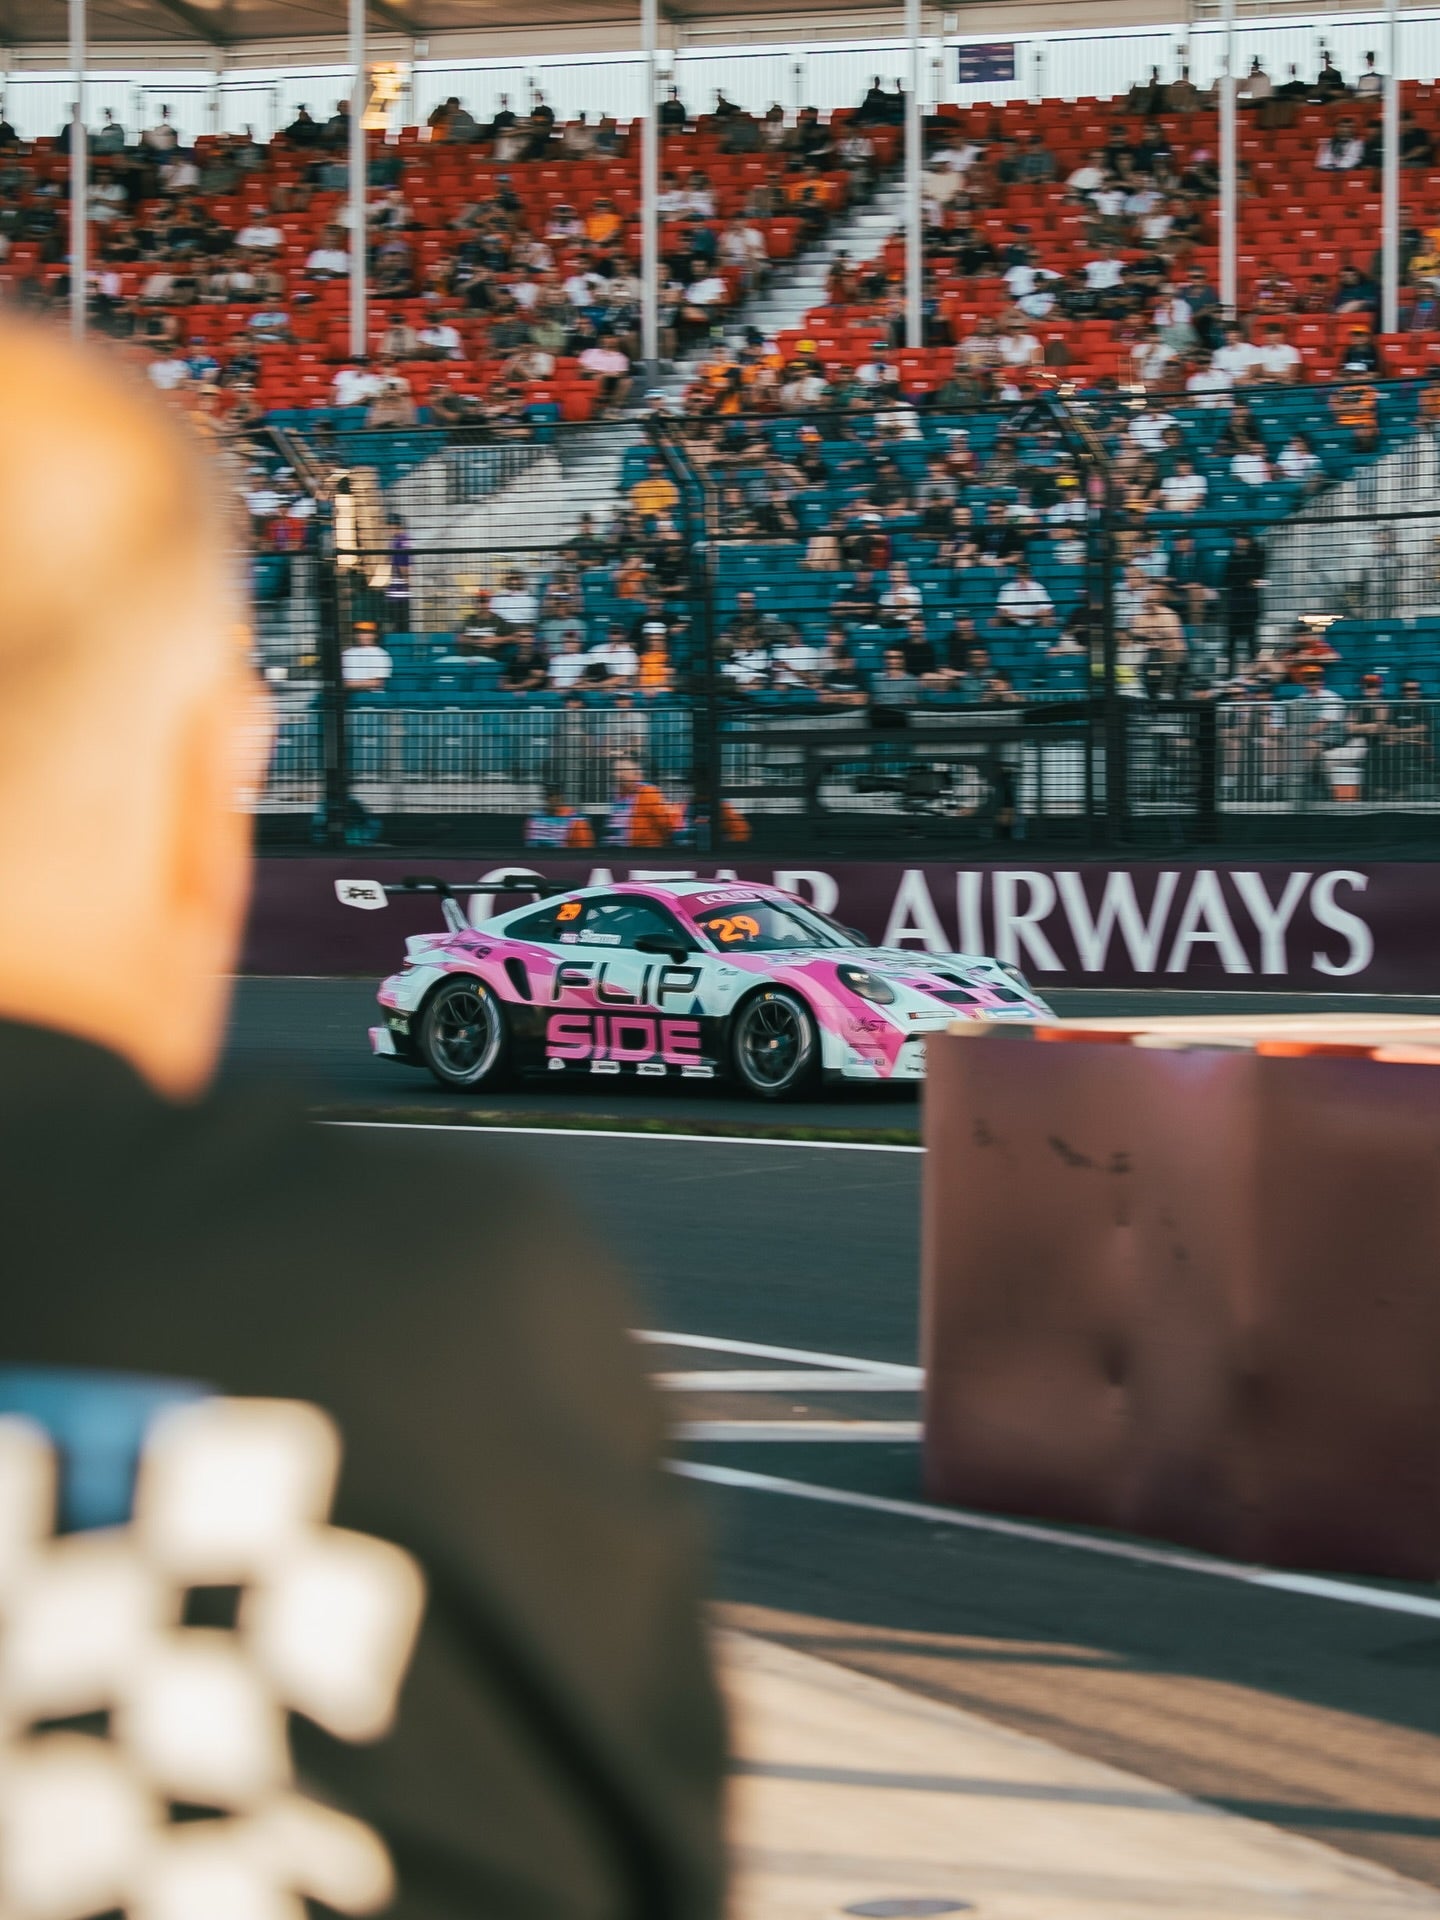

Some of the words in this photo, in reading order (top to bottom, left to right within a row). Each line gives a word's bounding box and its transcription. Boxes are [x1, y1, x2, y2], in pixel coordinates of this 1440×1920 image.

[707, 915, 761, 943] 29
[883, 868, 1371, 977] AIRWAYS
[552, 961, 703, 1007] FLIP
[545, 1014, 703, 1065] SIDE
